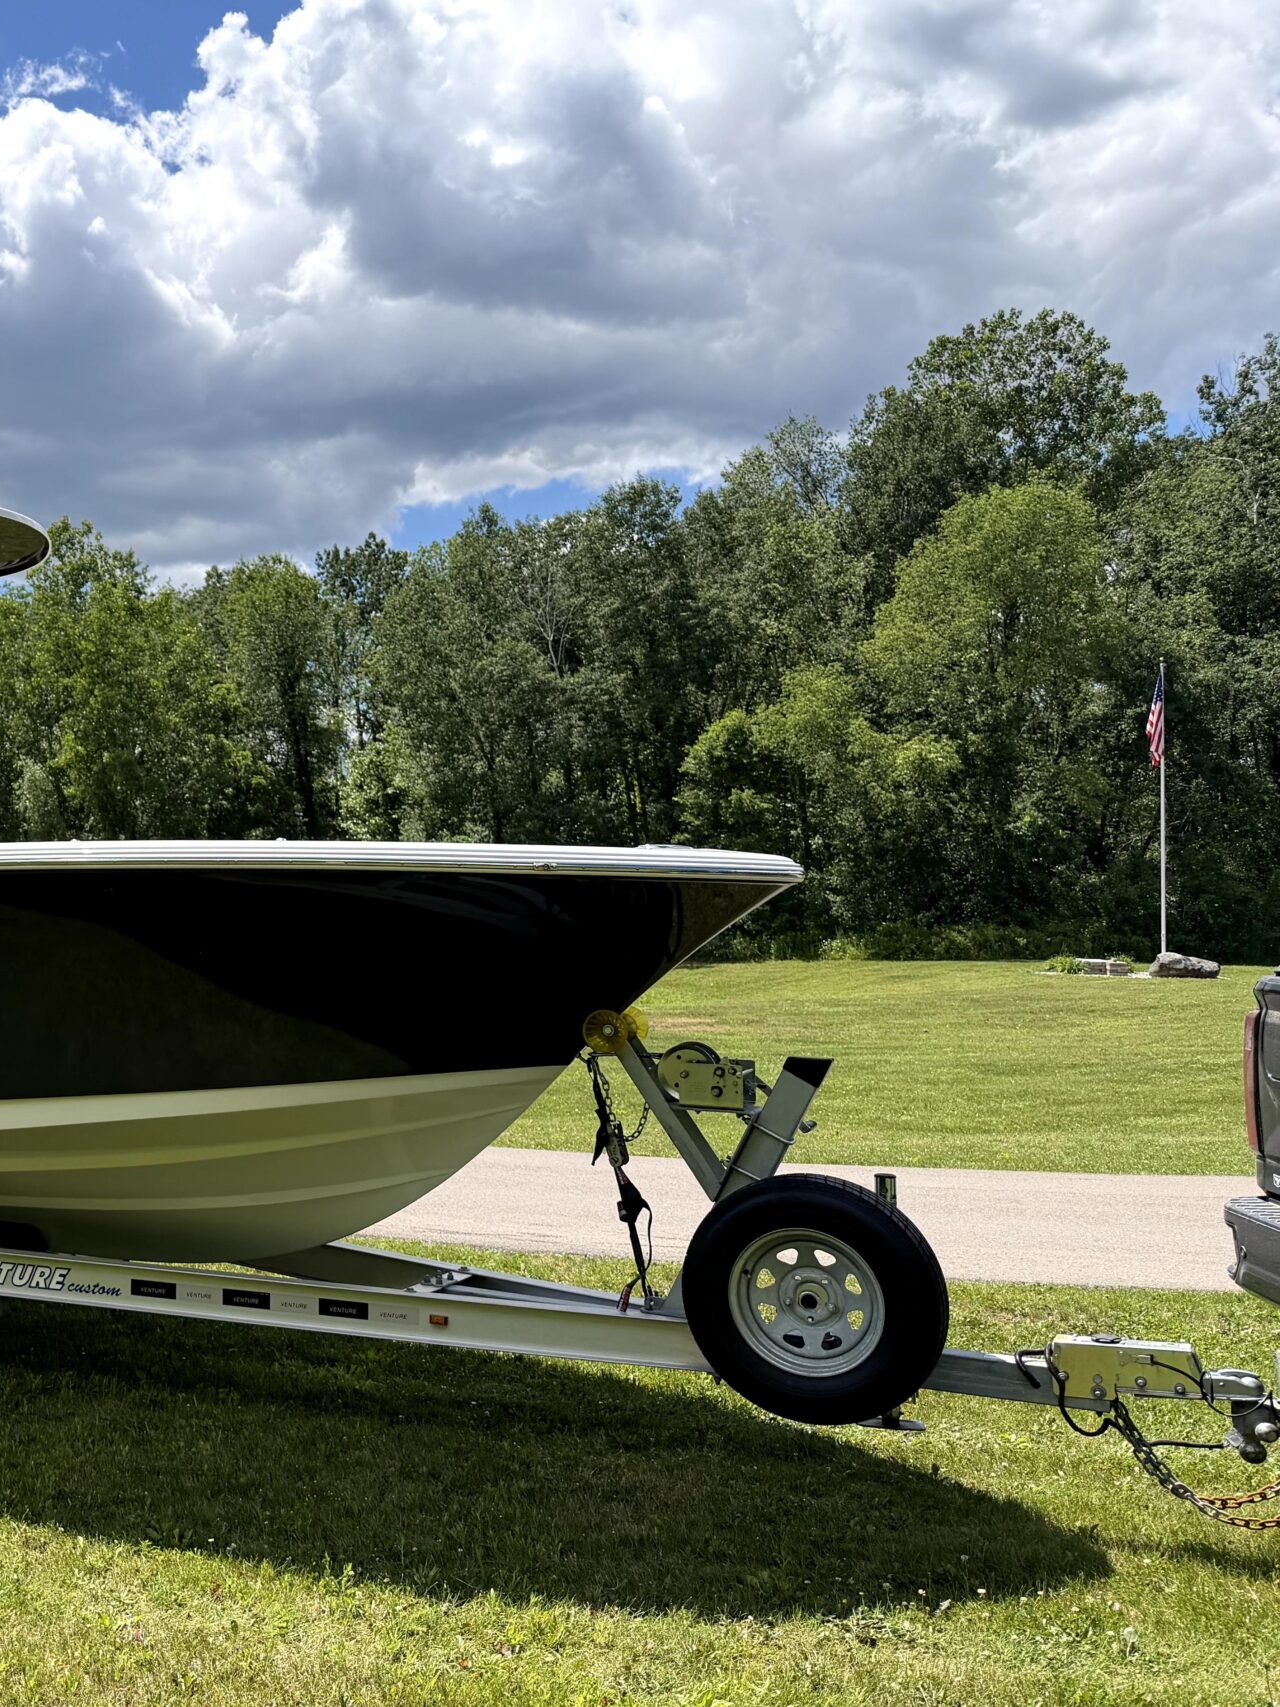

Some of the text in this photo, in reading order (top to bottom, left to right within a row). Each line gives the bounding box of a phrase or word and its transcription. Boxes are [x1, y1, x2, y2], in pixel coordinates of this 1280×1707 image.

[67, 1282, 122, 1296] custom
[186, 1291, 212, 1299] VENTURE
[233, 1296, 260, 1304] VENTURE
[280, 1301, 308, 1309] VENTURE
[329, 1306, 358, 1315] VENTURE
[379, 1311, 408, 1320] VENTURE
